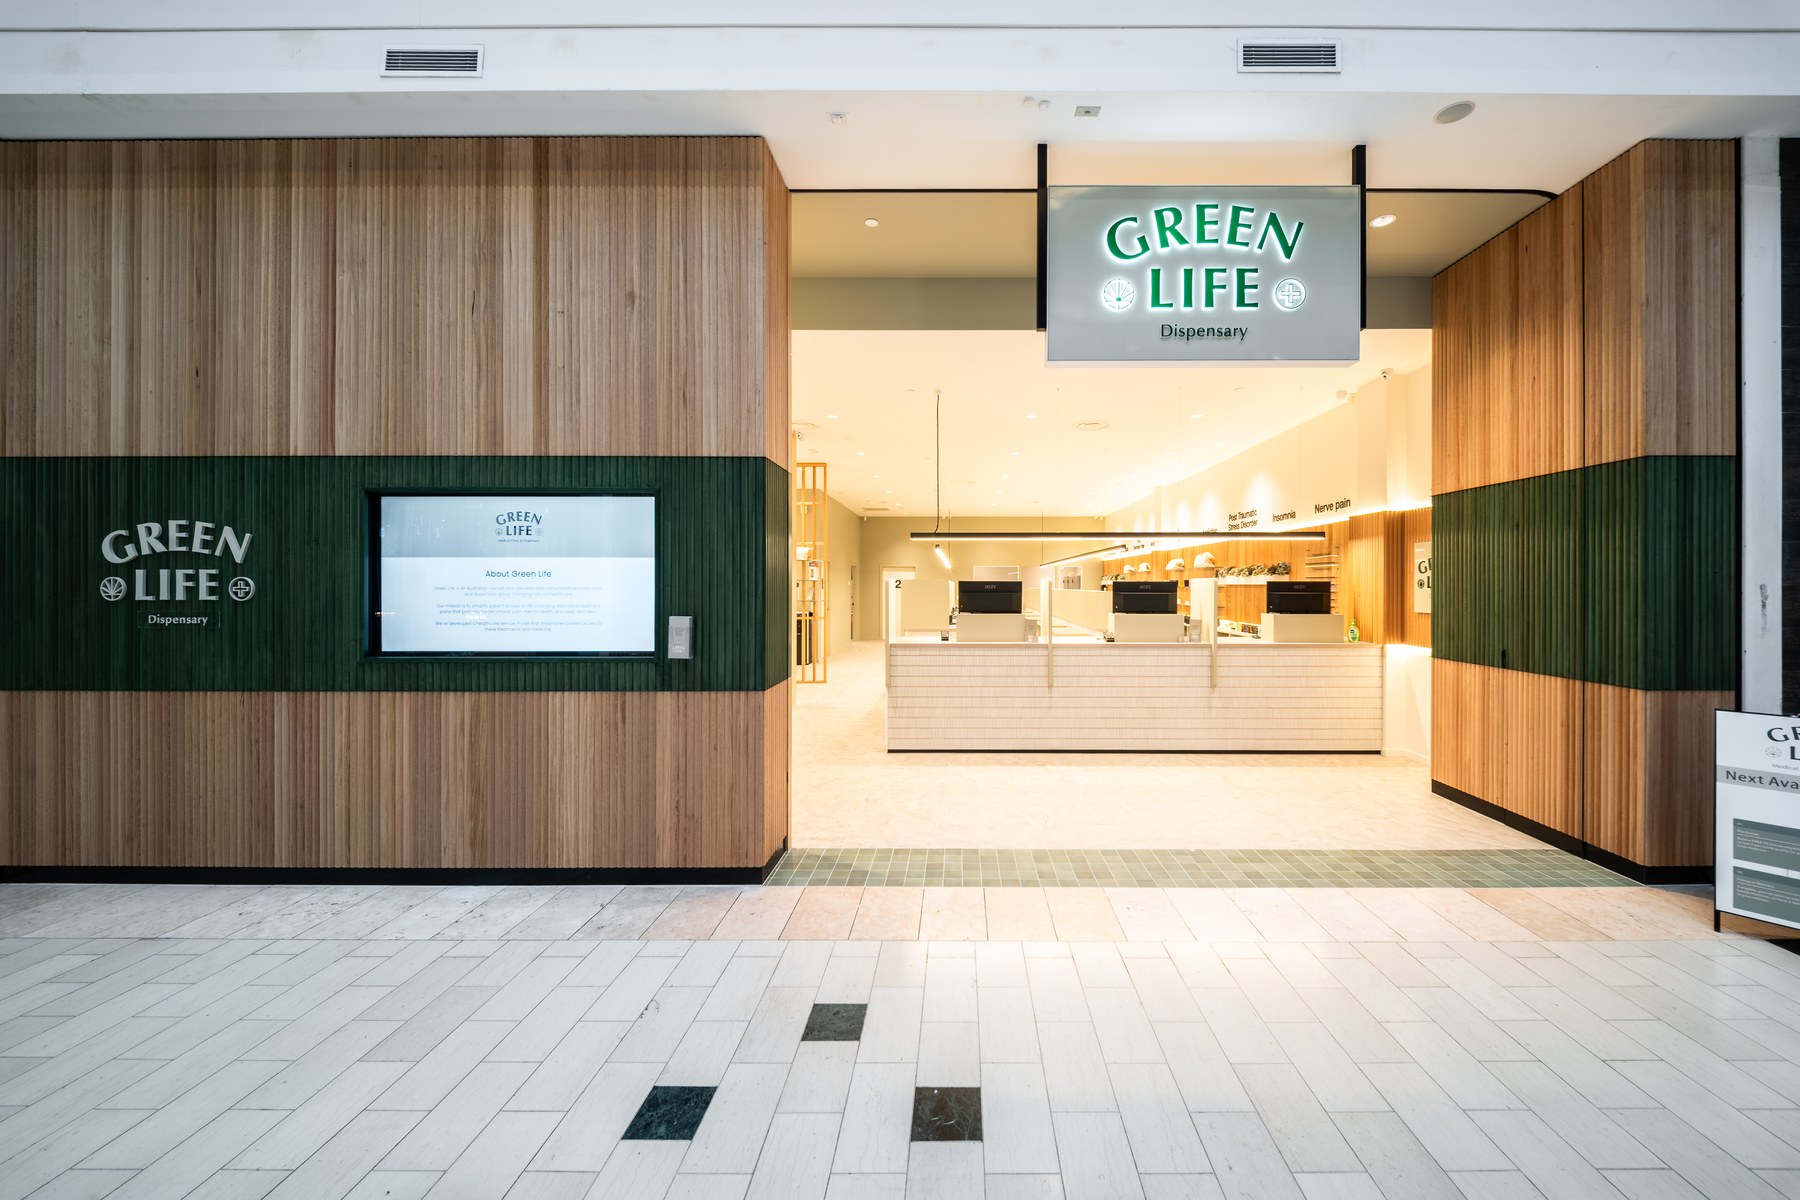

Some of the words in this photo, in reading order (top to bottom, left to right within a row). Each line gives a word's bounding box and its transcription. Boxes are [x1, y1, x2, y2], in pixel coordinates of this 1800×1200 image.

[1106, 204, 1304, 260] GREEN
[1151, 268, 1259, 308] LIFE
[1160, 324, 1248, 341] Dispensary
[1315, 502, 1334, 514] Nerve
[1335, 498, 1351, 512] pain
[496, 511, 543, 525] GREEN
[1228, 513, 1238, 522] Post
[1238, 509, 1257, 520] Traumatic
[1272, 510, 1296, 522] Insomnia
[506, 525, 532, 536] LIFE
[1228, 523, 1239, 531] Stress
[1240, 519, 1258, 529] Disorder
[101, 519, 254, 564] GREEN
[485, 570, 510, 578] About
[512, 570, 536, 578] Green
[538, 570, 552, 578] Life
[135, 568, 220, 601] LIFE
[895, 580, 902, 589] 2
[148, 614, 209, 627] Dispensary
[1726, 770, 1765, 785] Next
[1768, 776, 1800, 790] Ava
